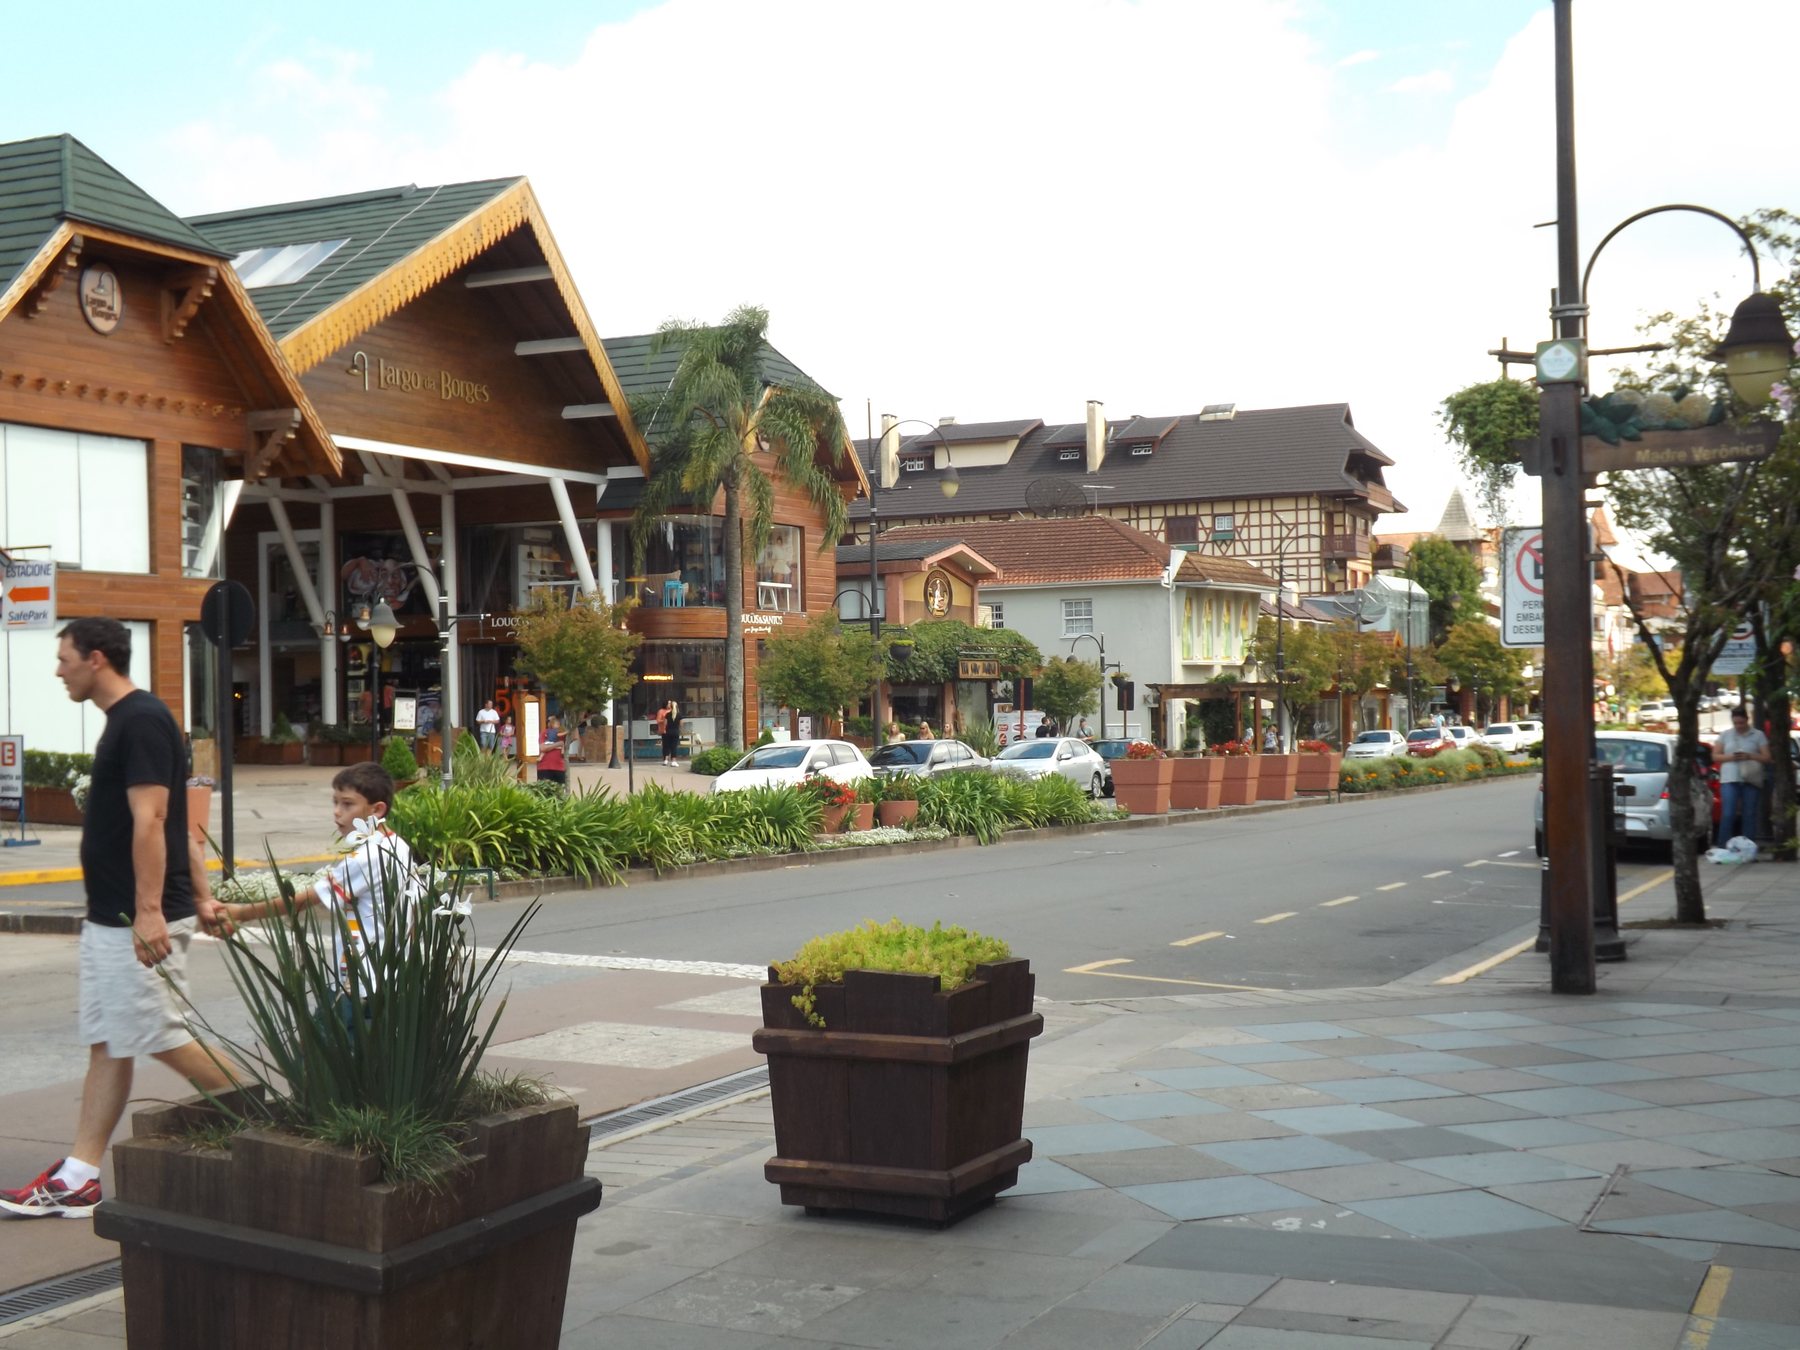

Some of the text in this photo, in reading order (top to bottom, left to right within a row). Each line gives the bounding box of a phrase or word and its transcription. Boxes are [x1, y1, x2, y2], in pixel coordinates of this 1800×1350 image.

[378, 358, 420, 392] Largo
[441, 370, 489, 404] Borges
[1636, 442, 1766, 463] Madre Verônica
[5, 563, 52, 578] ESTACIONE
[8, 610, 49, 621] SafePark
